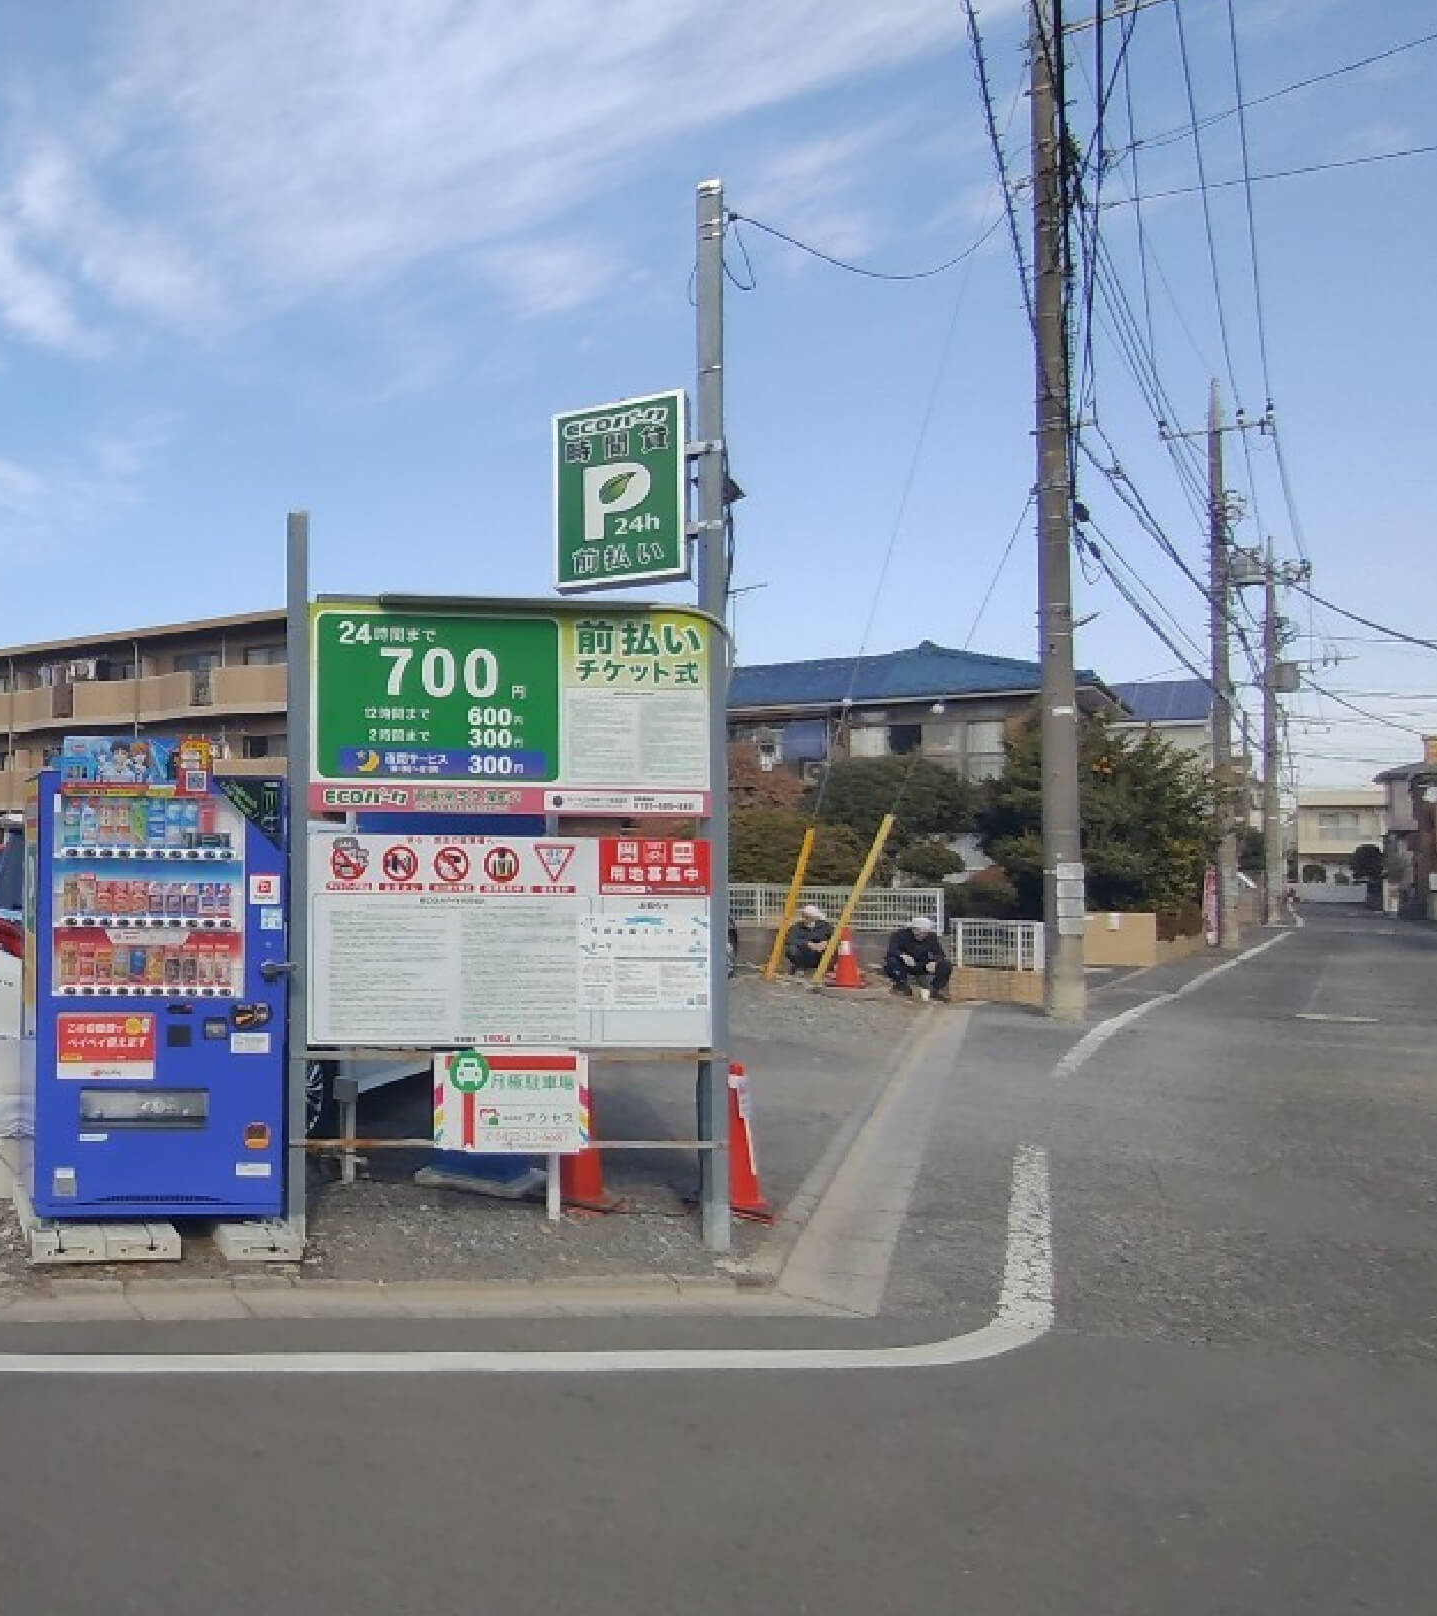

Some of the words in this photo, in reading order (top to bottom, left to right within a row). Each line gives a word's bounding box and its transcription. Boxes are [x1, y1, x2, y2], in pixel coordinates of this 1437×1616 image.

[565, 425, 668, 463] 時間貸
[583, 462, 651, 540] P
[614, 513, 660, 535] 24h
[572, 542, 664, 573] 前払い
[338, 620, 437, 644] 24時間まで
[575, 621, 701, 658] 前払い
[575, 659, 700, 685] チケット式
[364, 707, 431, 721] 12時間まで
[368, 728, 431, 742] 2時間まで
